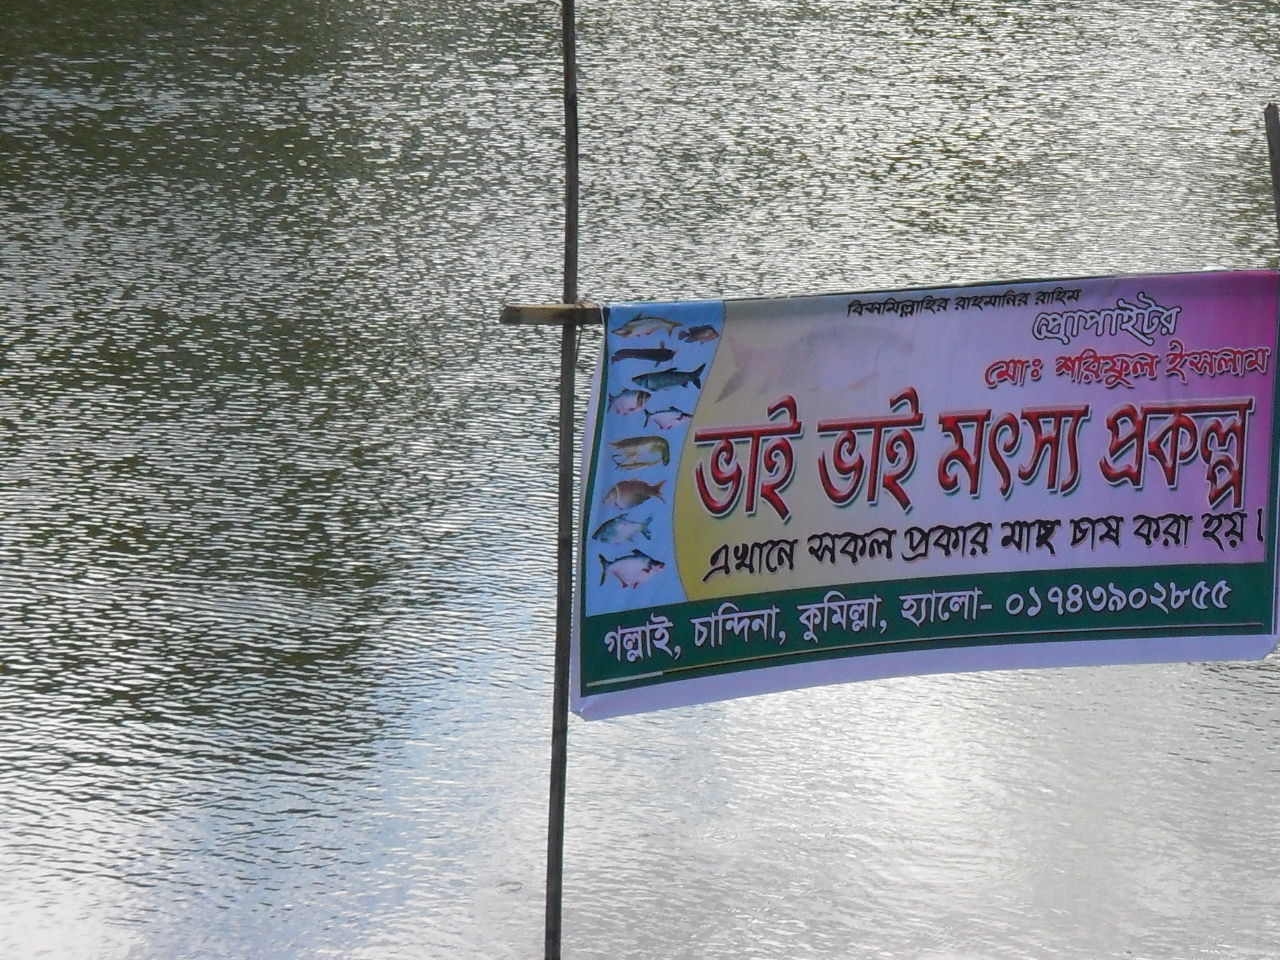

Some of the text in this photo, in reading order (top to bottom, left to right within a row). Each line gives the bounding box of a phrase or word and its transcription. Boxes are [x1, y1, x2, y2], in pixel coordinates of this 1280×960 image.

[954, 289, 1031, 313] রাহমানির
[1034, 286, 1082, 306] রাহিম
[1032, 291, 1182, 346] প্রোপাইটর
[1055, 348, 1160, 389] শরিফুল
[1165, 339, 1270, 384] ইসলাম
[694, 386, 1255, 524] ভাই ভাই মৎস্য প্রকল্প
[702, 538, 799, 583] এখানে
[807, 527, 897, 564] সকল
[901, 522, 992, 562] প্রকার
[1001, 519, 1062, 556] মাছ
[1070, 514, 1124, 550] চাষ
[1133, 513, 1193, 548] করা
[604, 613, 682, 662] গল্লাই,
[690, 602, 786, 646] চান্দিনা,
[796, 590, 888, 643] কুমিল্লা,
[1005, 579, 1233, 617] ০১৭৪৩৯০২৮৫৫
